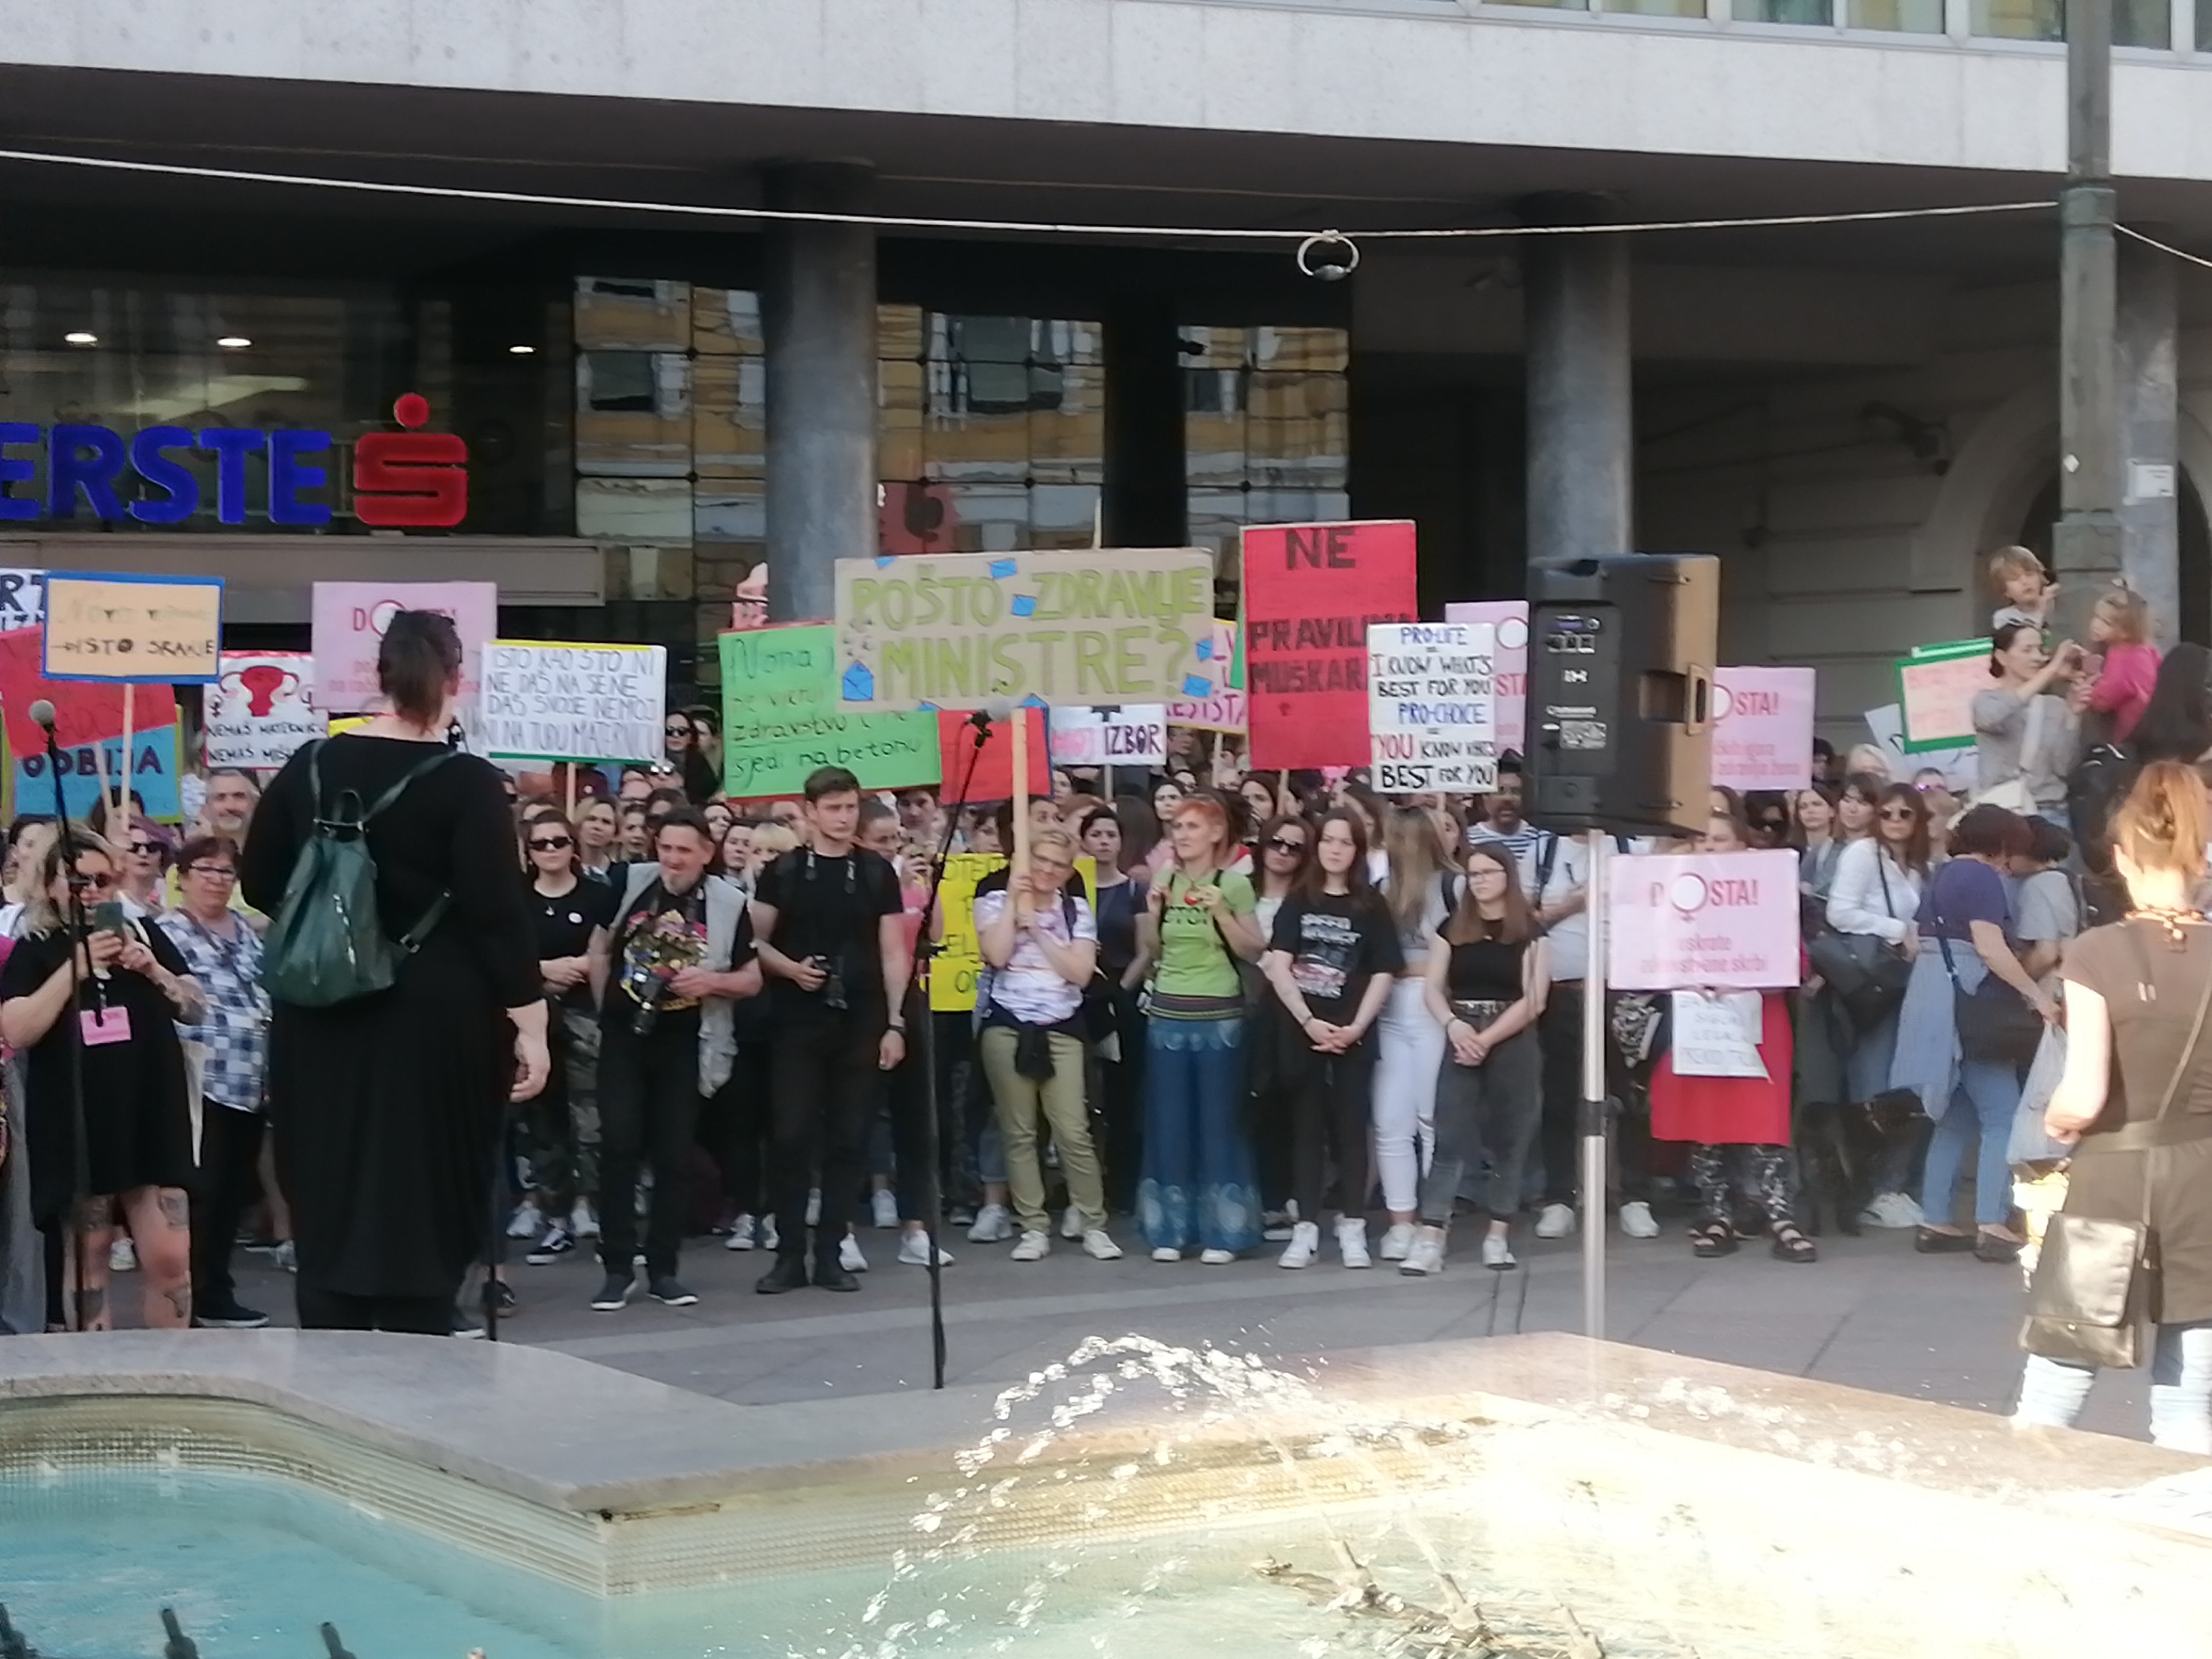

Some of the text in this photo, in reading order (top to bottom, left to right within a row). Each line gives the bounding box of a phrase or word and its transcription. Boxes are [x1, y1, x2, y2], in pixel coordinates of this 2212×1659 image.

[0, 423, 331, 524] ERSTE
[1285, 527, 1357, 571] NE
[850, 564, 1002, 631] POŠTO
[1400, 626, 1468, 646] PRO-LIFE
[881, 626, 1192, 700] MINISTRE?
[1378, 680, 1421, 697] BEST
[1427, 678, 1458, 696] FOR
[1104, 723, 1162, 756] IZBOR
[1381, 764, 1434, 789] BEST
